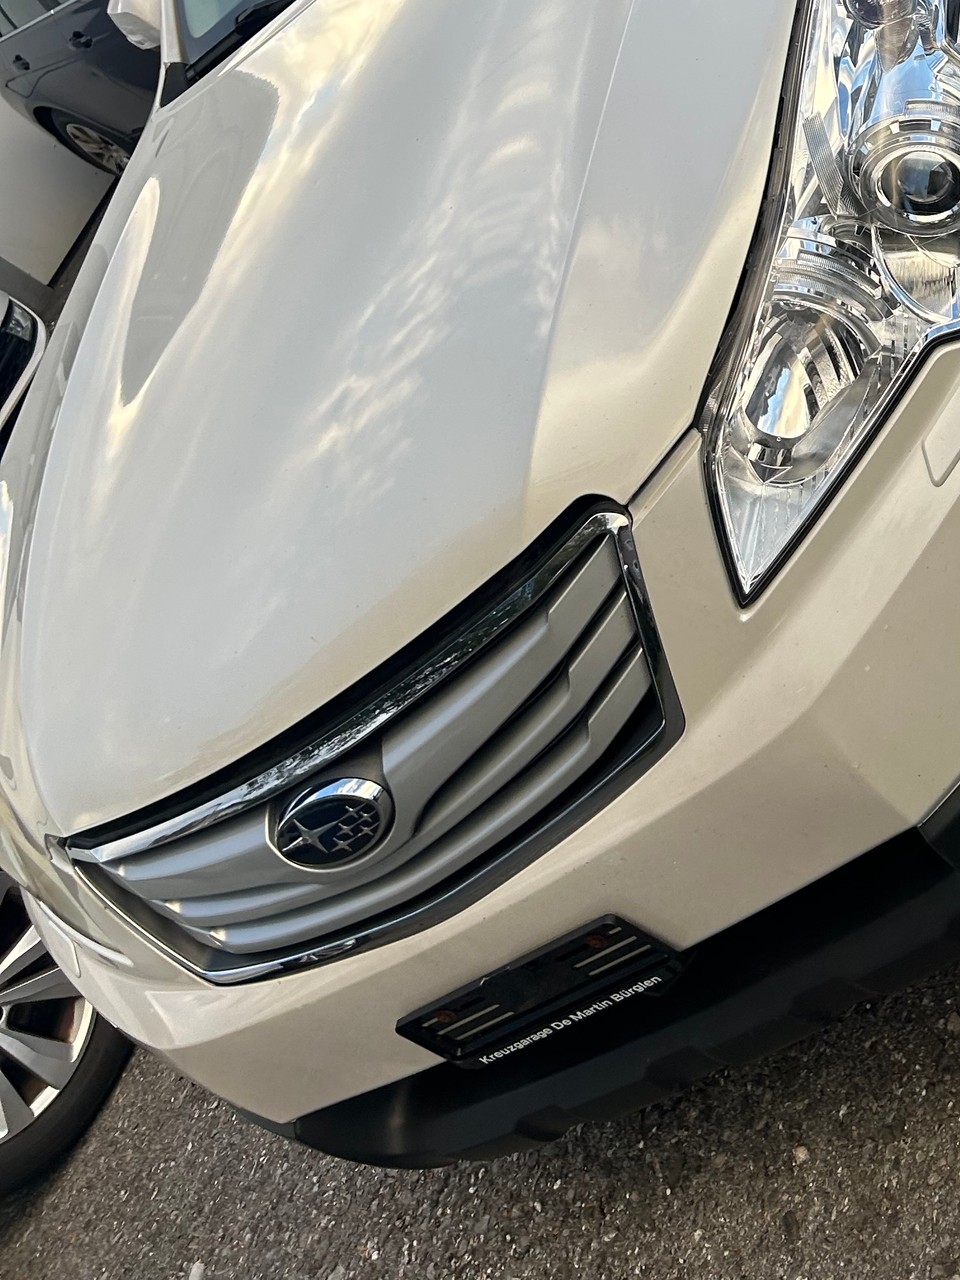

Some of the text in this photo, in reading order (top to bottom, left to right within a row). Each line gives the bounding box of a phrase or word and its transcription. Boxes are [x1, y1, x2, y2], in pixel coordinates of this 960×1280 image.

[479, 975, 662, 1065] Kreuzgarage De Martin Bürglen
